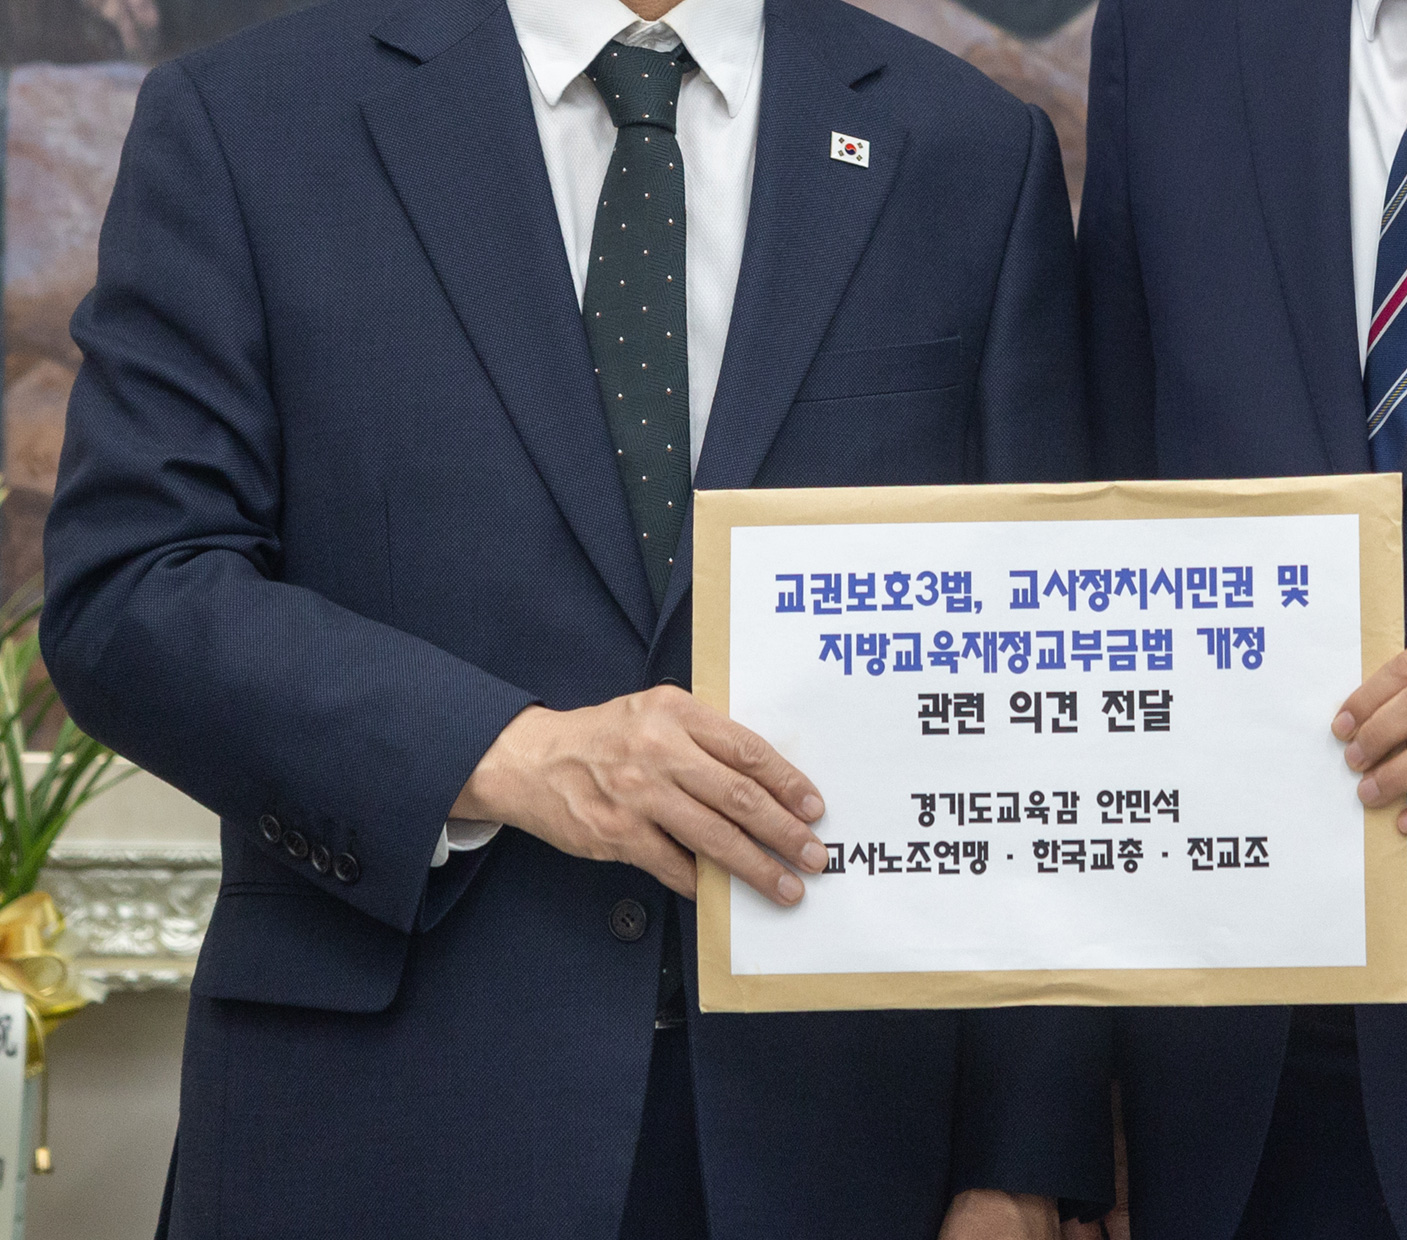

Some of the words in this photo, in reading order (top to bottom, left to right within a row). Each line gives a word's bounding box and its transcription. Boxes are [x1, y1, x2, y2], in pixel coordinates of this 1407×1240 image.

[775, 570, 984, 617] 교권보호3법,
[1009, 566, 1255, 614] 교사정치시민권
[1277, 564, 1310, 609] 및
[819, 628, 1175, 678] 지방교육재정교부금법
[1197, 626, 1267, 672] 개정
[917, 692, 987, 737] 관련
[1009, 690, 1080, 735] 의견
[1101, 689, 1175, 734] 전달
[911, 790, 1082, 829] 경기도교육감
[1096, 789, 1181, 826] 안민석
[1032, 838, 1145, 875] 한국교총
[1187, 836, 1271, 873] 전교조
